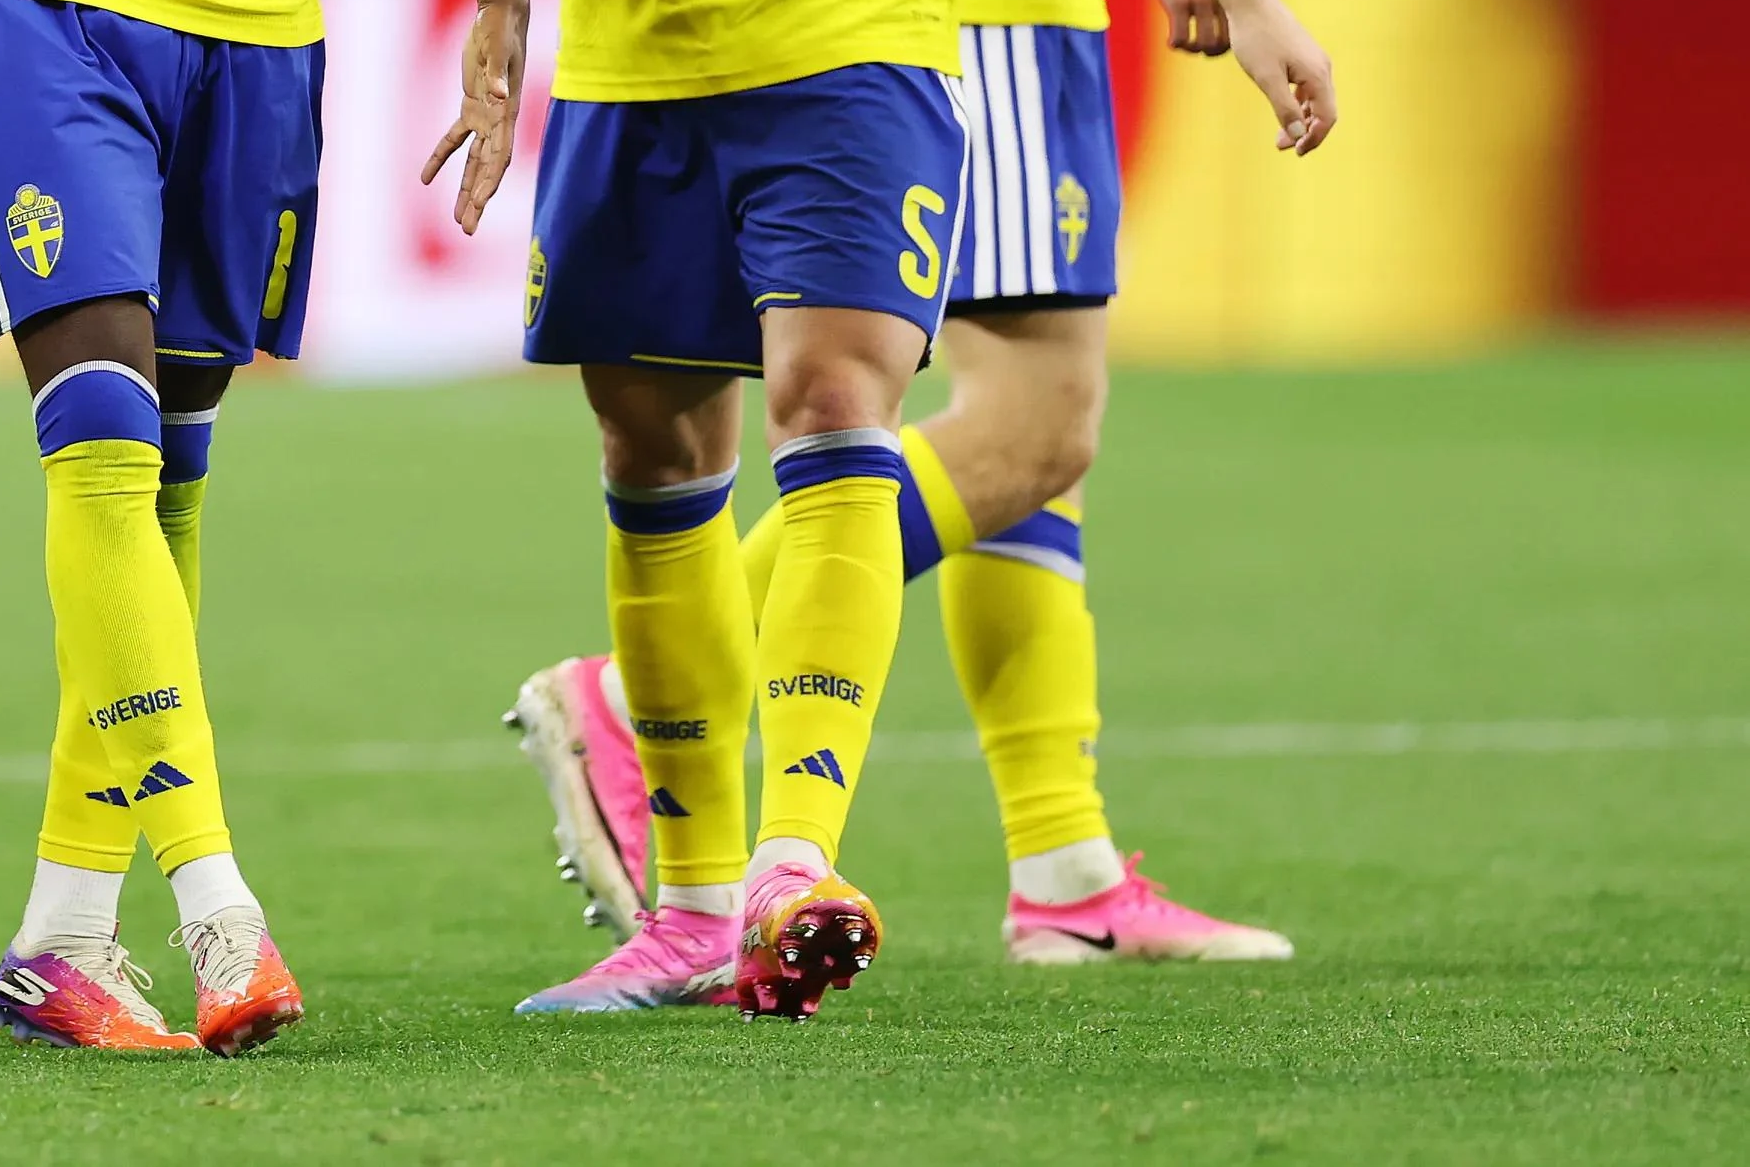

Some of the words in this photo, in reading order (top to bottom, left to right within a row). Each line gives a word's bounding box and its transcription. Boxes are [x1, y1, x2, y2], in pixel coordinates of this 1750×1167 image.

[12, 206, 51, 225] SVERIGE
[898, 184, 945, 299] 5
[96, 687, 182, 730] SVERIGE
[768, 674, 864, 707] SVERIGE
